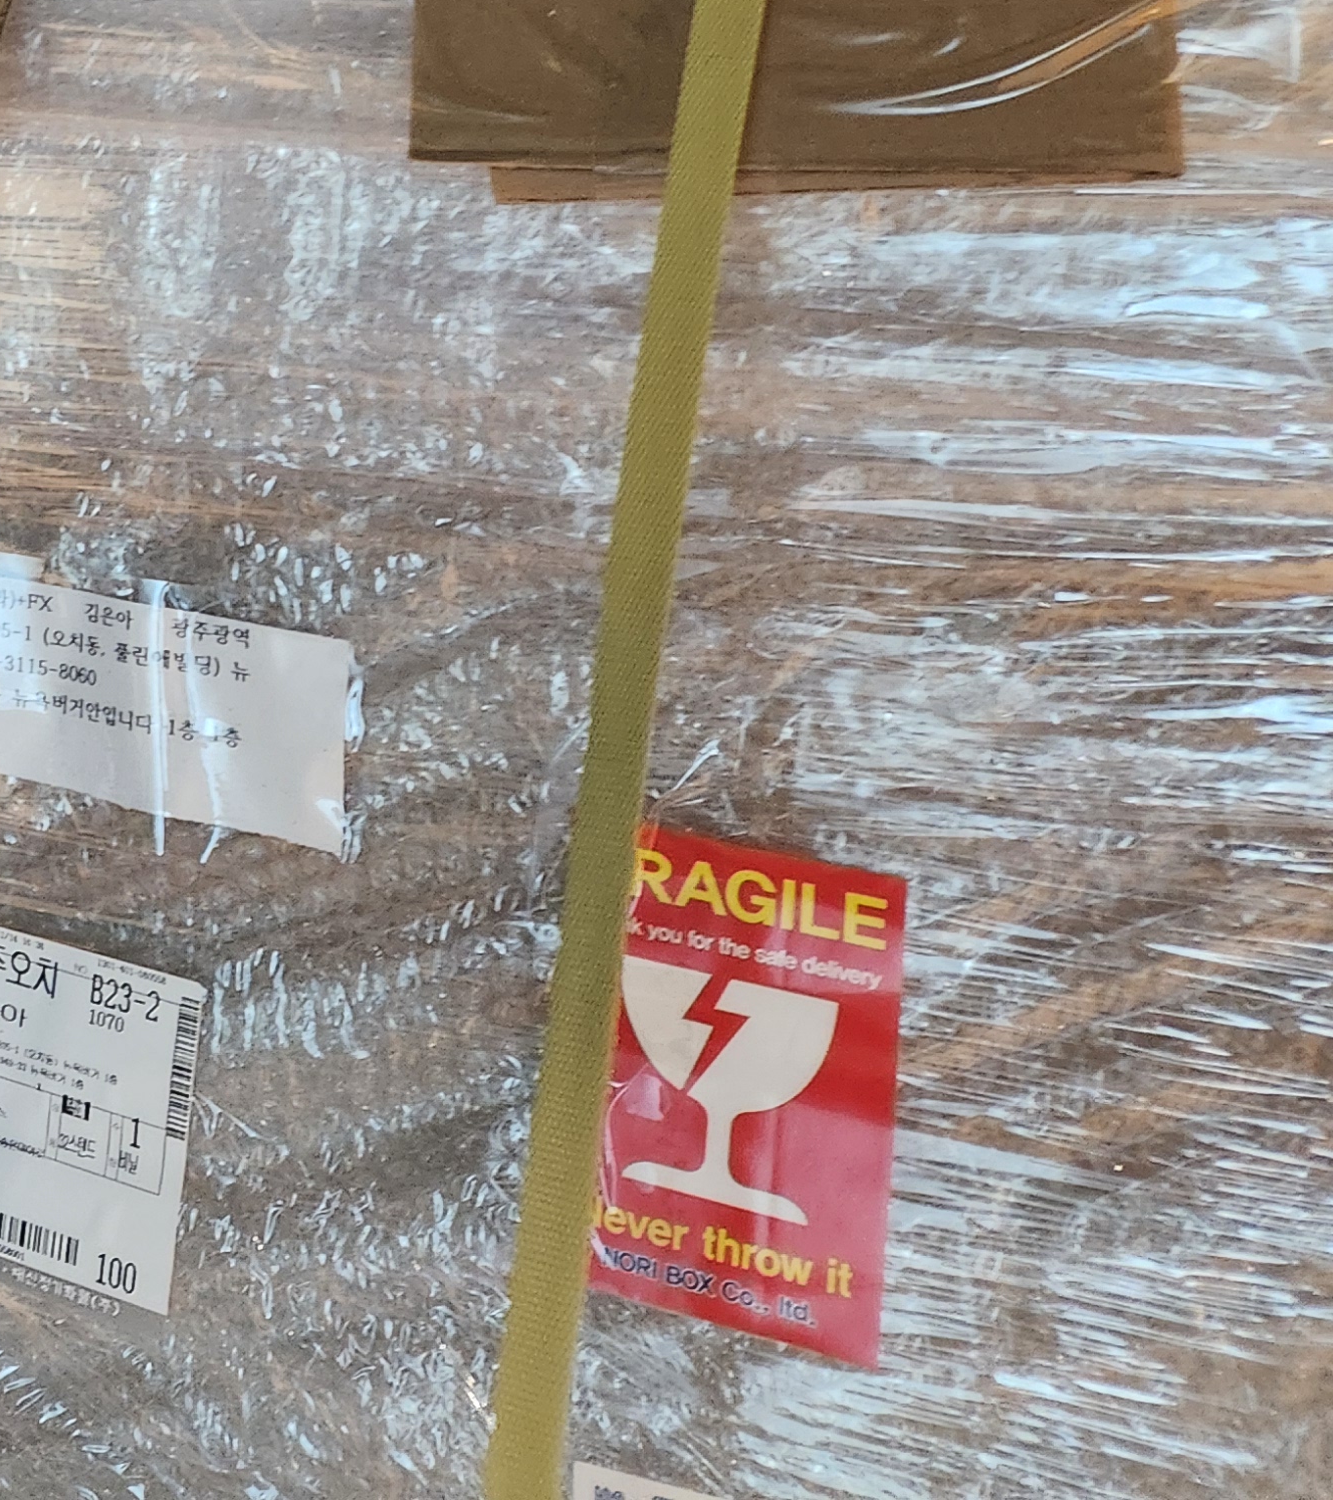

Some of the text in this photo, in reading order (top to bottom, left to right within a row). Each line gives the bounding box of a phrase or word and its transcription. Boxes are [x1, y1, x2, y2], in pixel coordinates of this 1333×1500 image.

[84, 603, 135, 631] 김은아
[171, 618, 251, 650] 광주광역
[231, 661, 252, 684] 뉴
[167, 718, 199, 742] 1층
[633, 848, 889, 950] RAGILE
[646, 925, 685, 949] you
[686, 930, 715, 955] for
[718, 937, 750, 961] the
[753, 944, 797, 972] safe
[800, 954, 884, 992] delivery
[88, 1009, 125, 1033] 1070
[89, 973, 162, 1023] B23-2
[129, 1116, 142, 1150] 1
[95, 1253, 138, 1295] 100
[701, 1225, 814, 1288] throw
[826, 1257, 853, 1299] it
[601, 1245, 817, 1328] NORI BOX Co., ltd.
